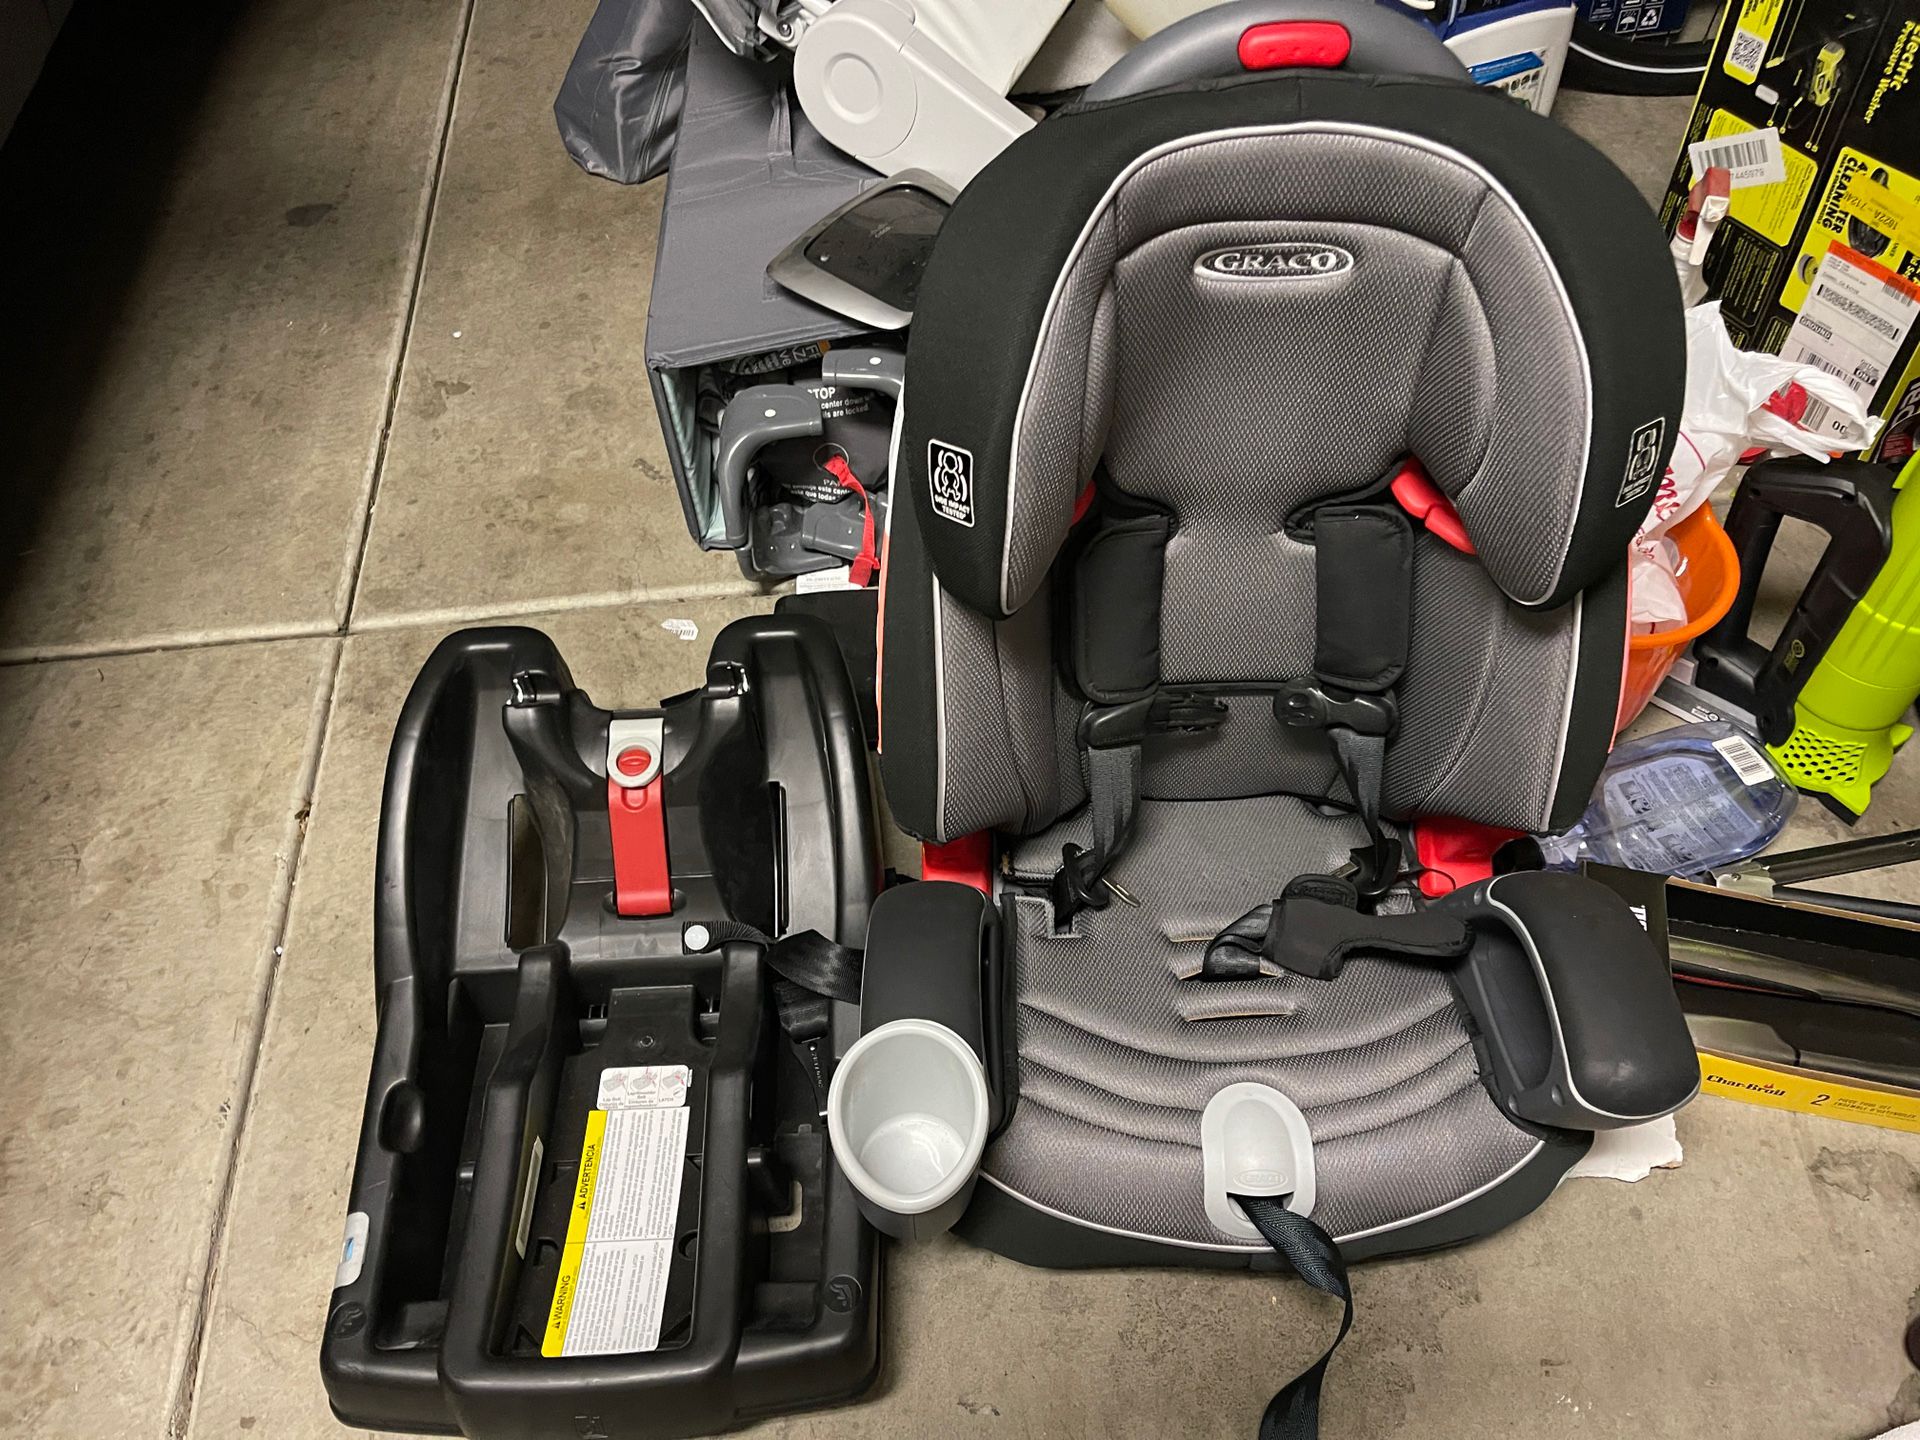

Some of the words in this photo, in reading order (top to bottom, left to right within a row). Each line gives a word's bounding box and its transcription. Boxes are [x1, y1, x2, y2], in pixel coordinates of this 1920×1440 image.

[1884, 20, 1916, 75] Pressure
[1864, 78, 1891, 124] Washer
[1822, 156, 1858, 229] CLEANING
[1214, 252, 1337, 271] GRACO
[821, 400, 843, 410] center
[832, 409, 844, 418] are
[1706, 1074, 1787, 1097] Char-Broil
[1810, 1093, 1831, 1107] 2
[579, 1143, 596, 1199] ADVERTENCIA
[553, 1274, 571, 1321] WARNING
